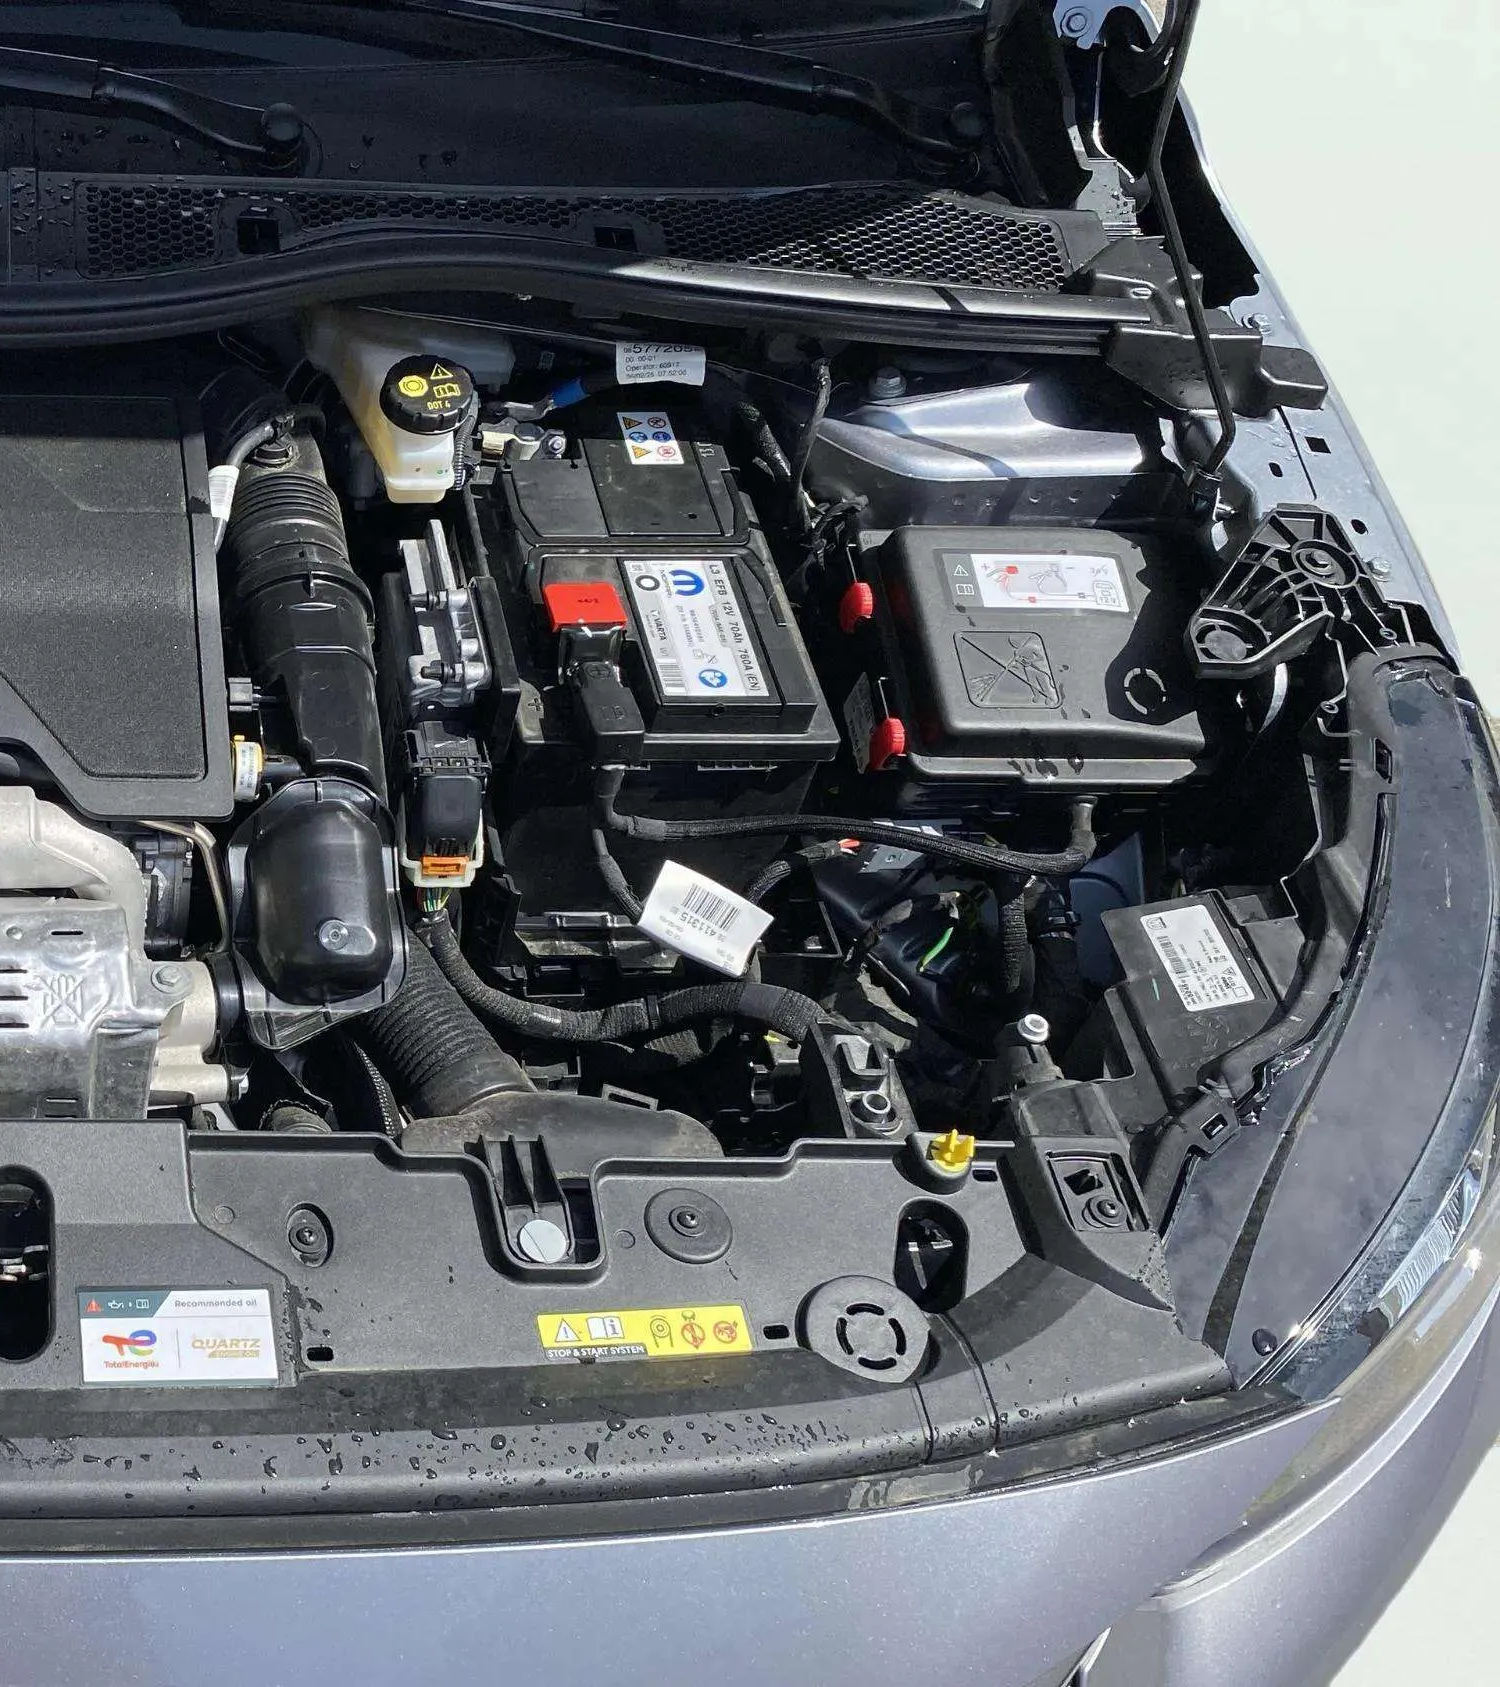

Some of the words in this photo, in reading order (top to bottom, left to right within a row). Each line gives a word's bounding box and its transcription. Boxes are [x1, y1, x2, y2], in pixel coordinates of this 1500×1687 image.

[427, 400, 444, 410] DOT
[708, 565, 720, 575] L3
[714, 579, 727, 596] EFB
[721, 601, 734, 616] 12V
[728, 622, 743, 643] 70Ah
[655, 618, 668, 641] VARTA
[679, 912, 717, 937] 411315
[174, 1299, 243, 1308] Recommended
[245, 1299, 257, 1307] oil
[191, 1338, 260, 1351] QUARTZ
[548, 1349, 572, 1358] STOP
[573, 1348, 580, 1357] &
[581, 1346, 608, 1356] START
